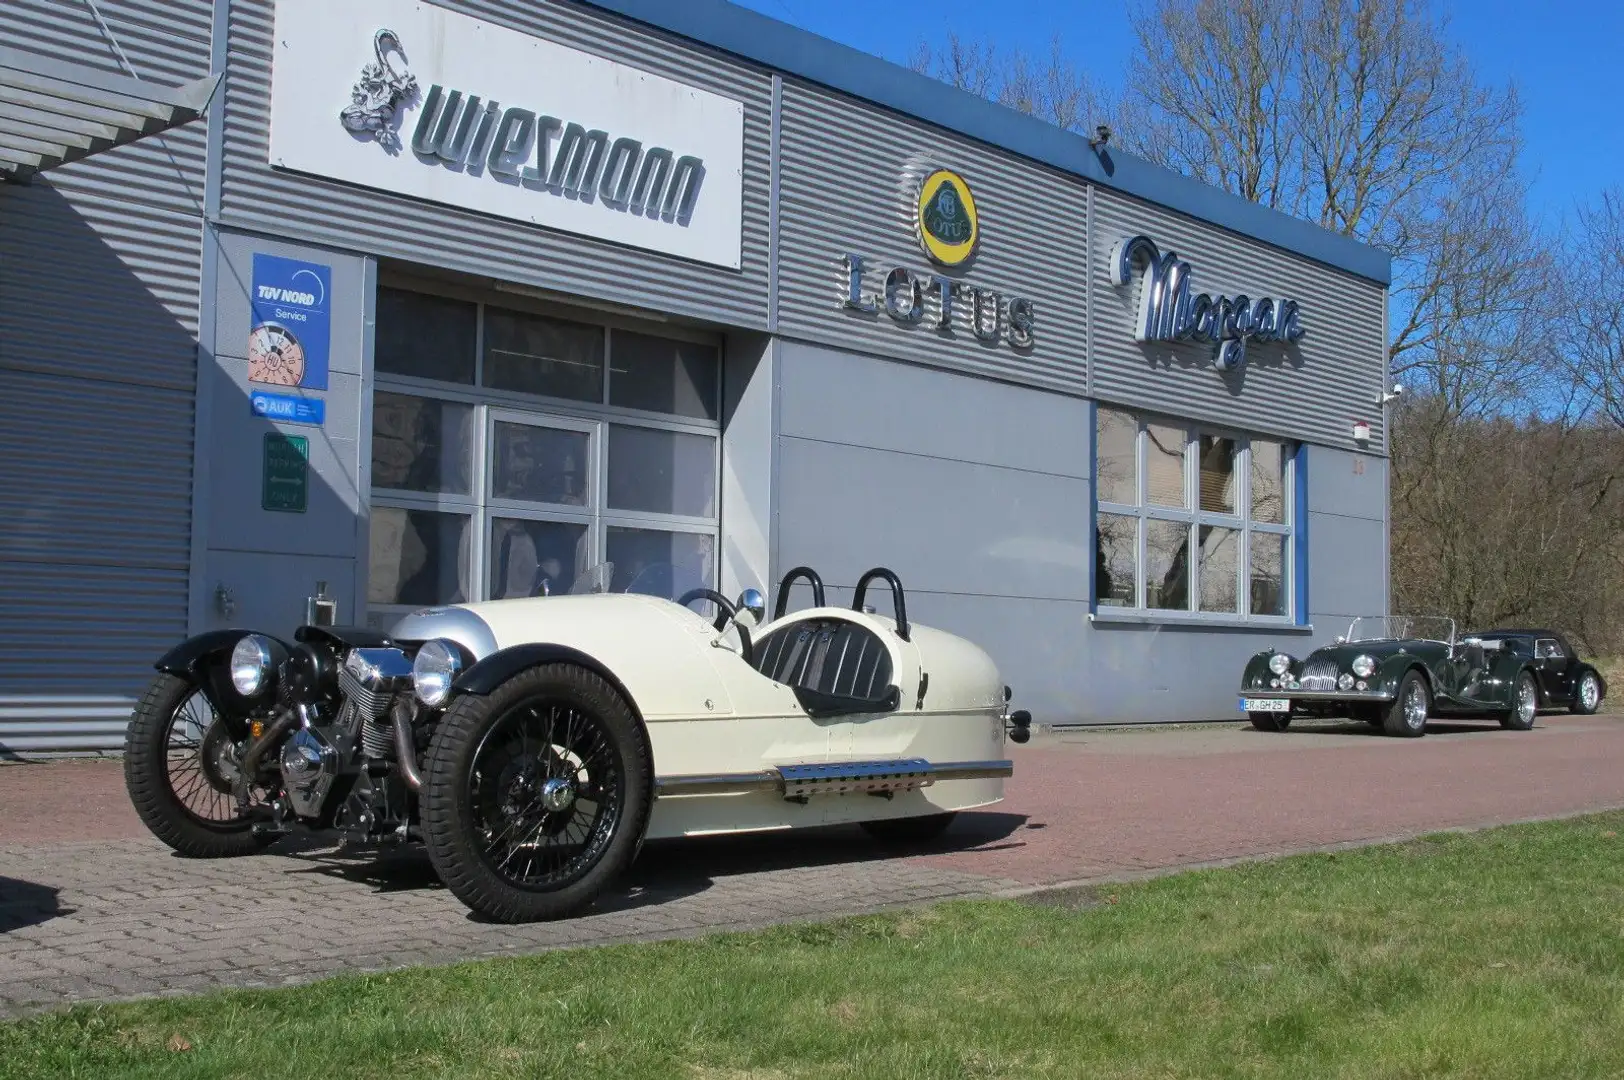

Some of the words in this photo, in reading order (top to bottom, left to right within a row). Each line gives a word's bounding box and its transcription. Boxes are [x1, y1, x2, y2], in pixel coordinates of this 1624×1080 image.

[411, 84, 704, 219] Wiesmann
[275, 308, 307, 322] Service
[281, 289, 315, 306] NORD
[843, 253, 1035, 348] LOTUS
[1109, 235, 1306, 371] Morgan
[267, 354, 279, 368] HU
